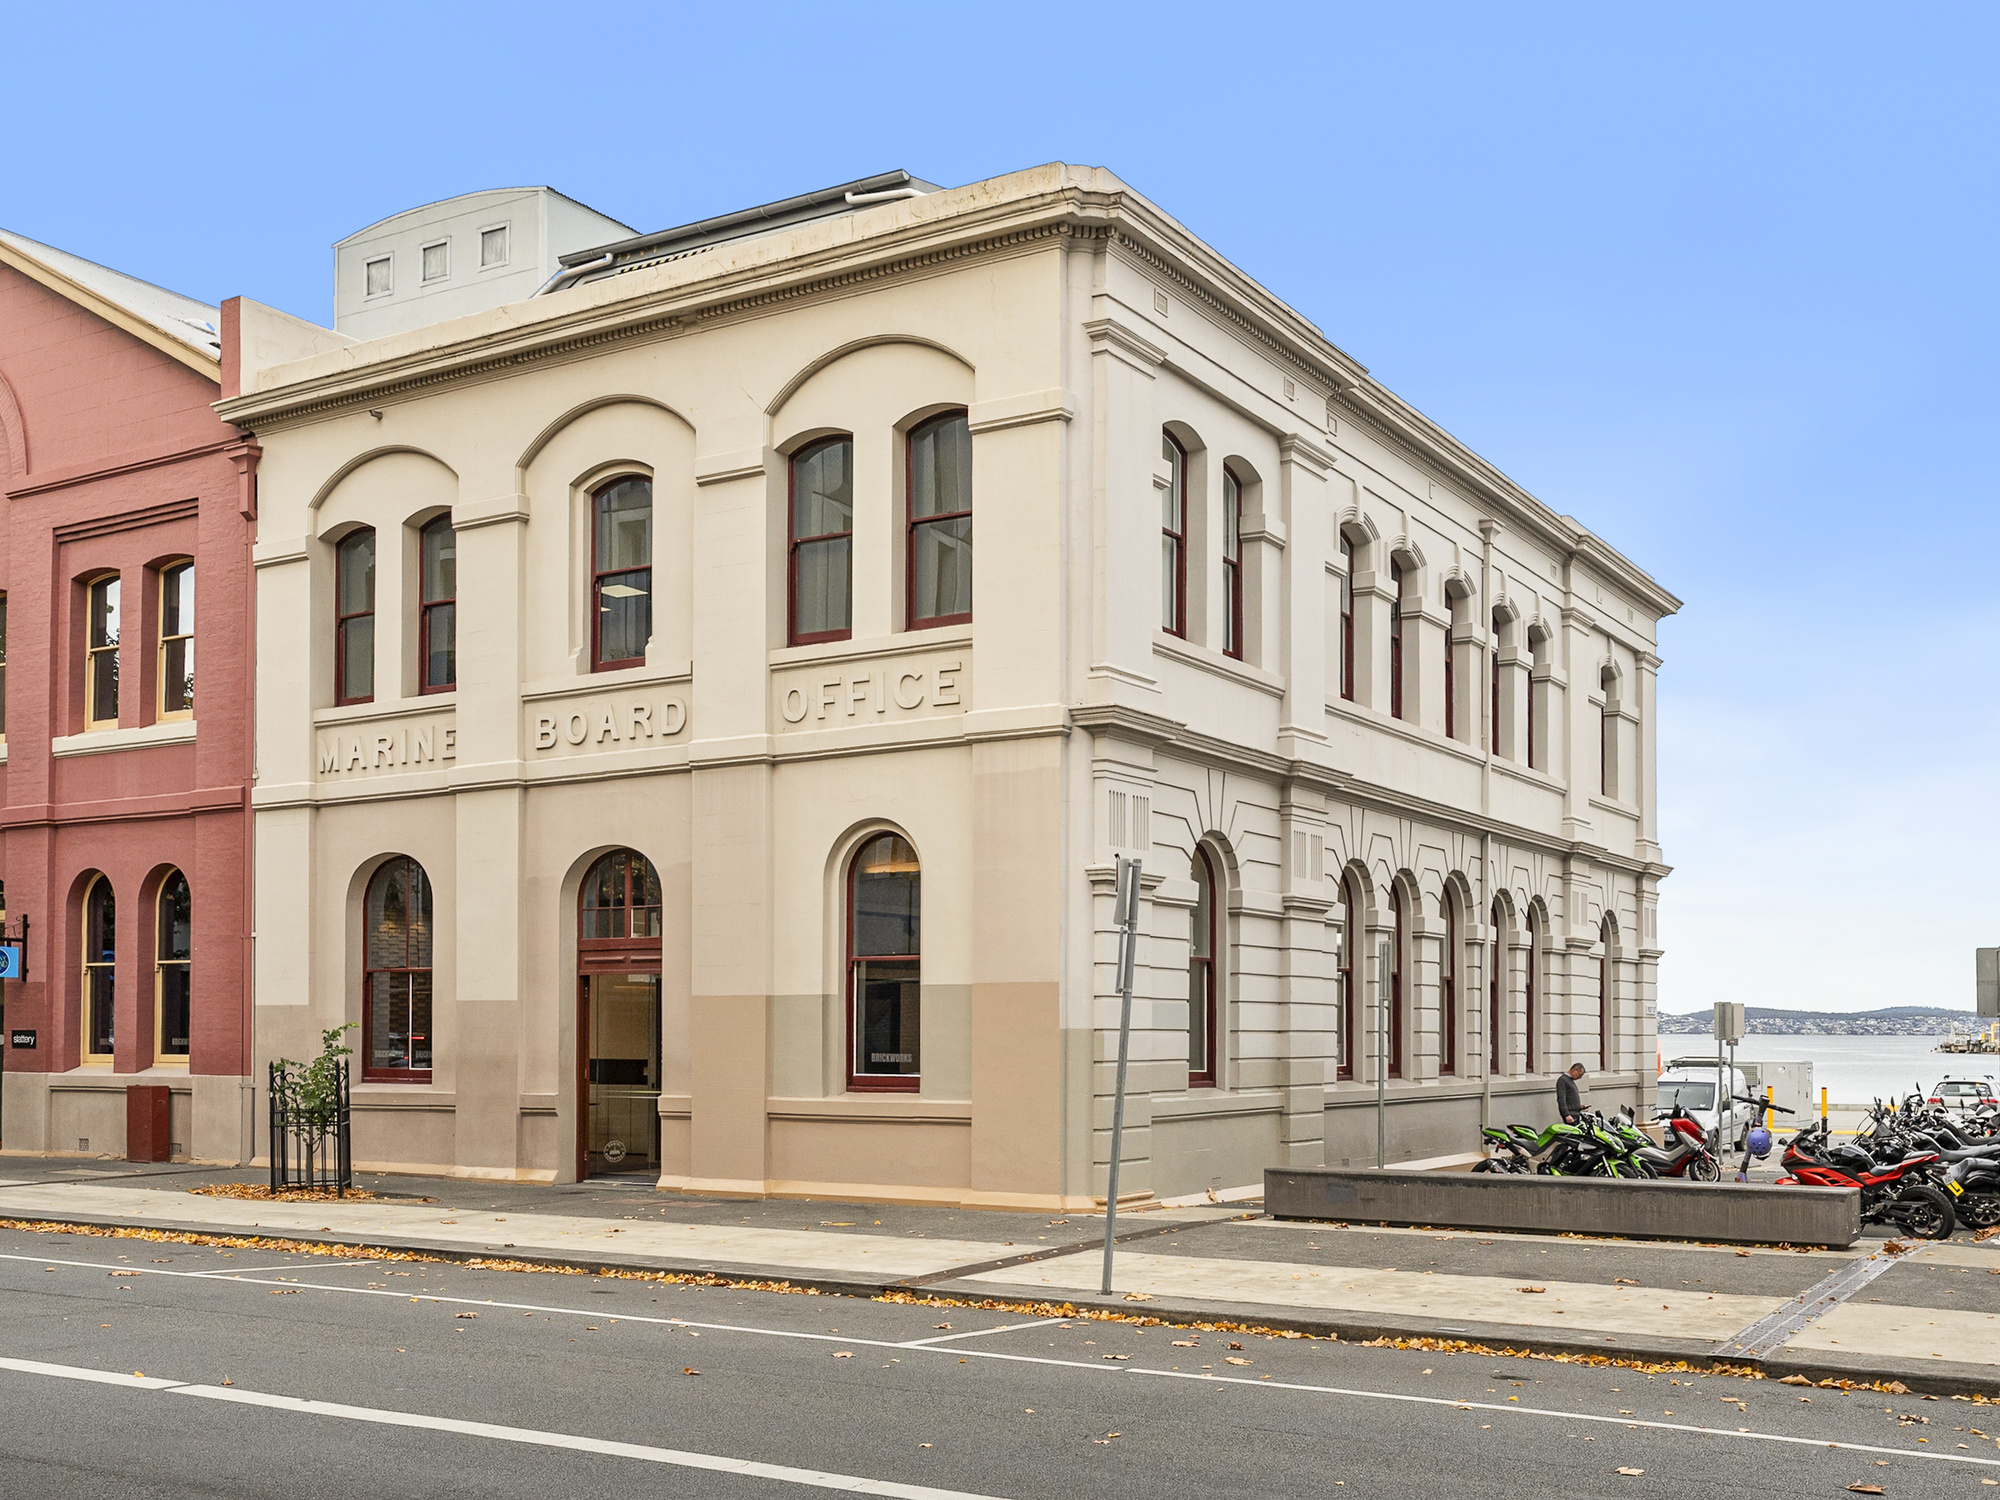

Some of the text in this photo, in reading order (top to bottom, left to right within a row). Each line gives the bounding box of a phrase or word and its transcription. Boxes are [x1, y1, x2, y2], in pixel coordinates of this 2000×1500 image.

[318, 661, 962, 774] MARINE BOARD OFFICE
[871, 1053, 913, 1063] BRICKWORKS
